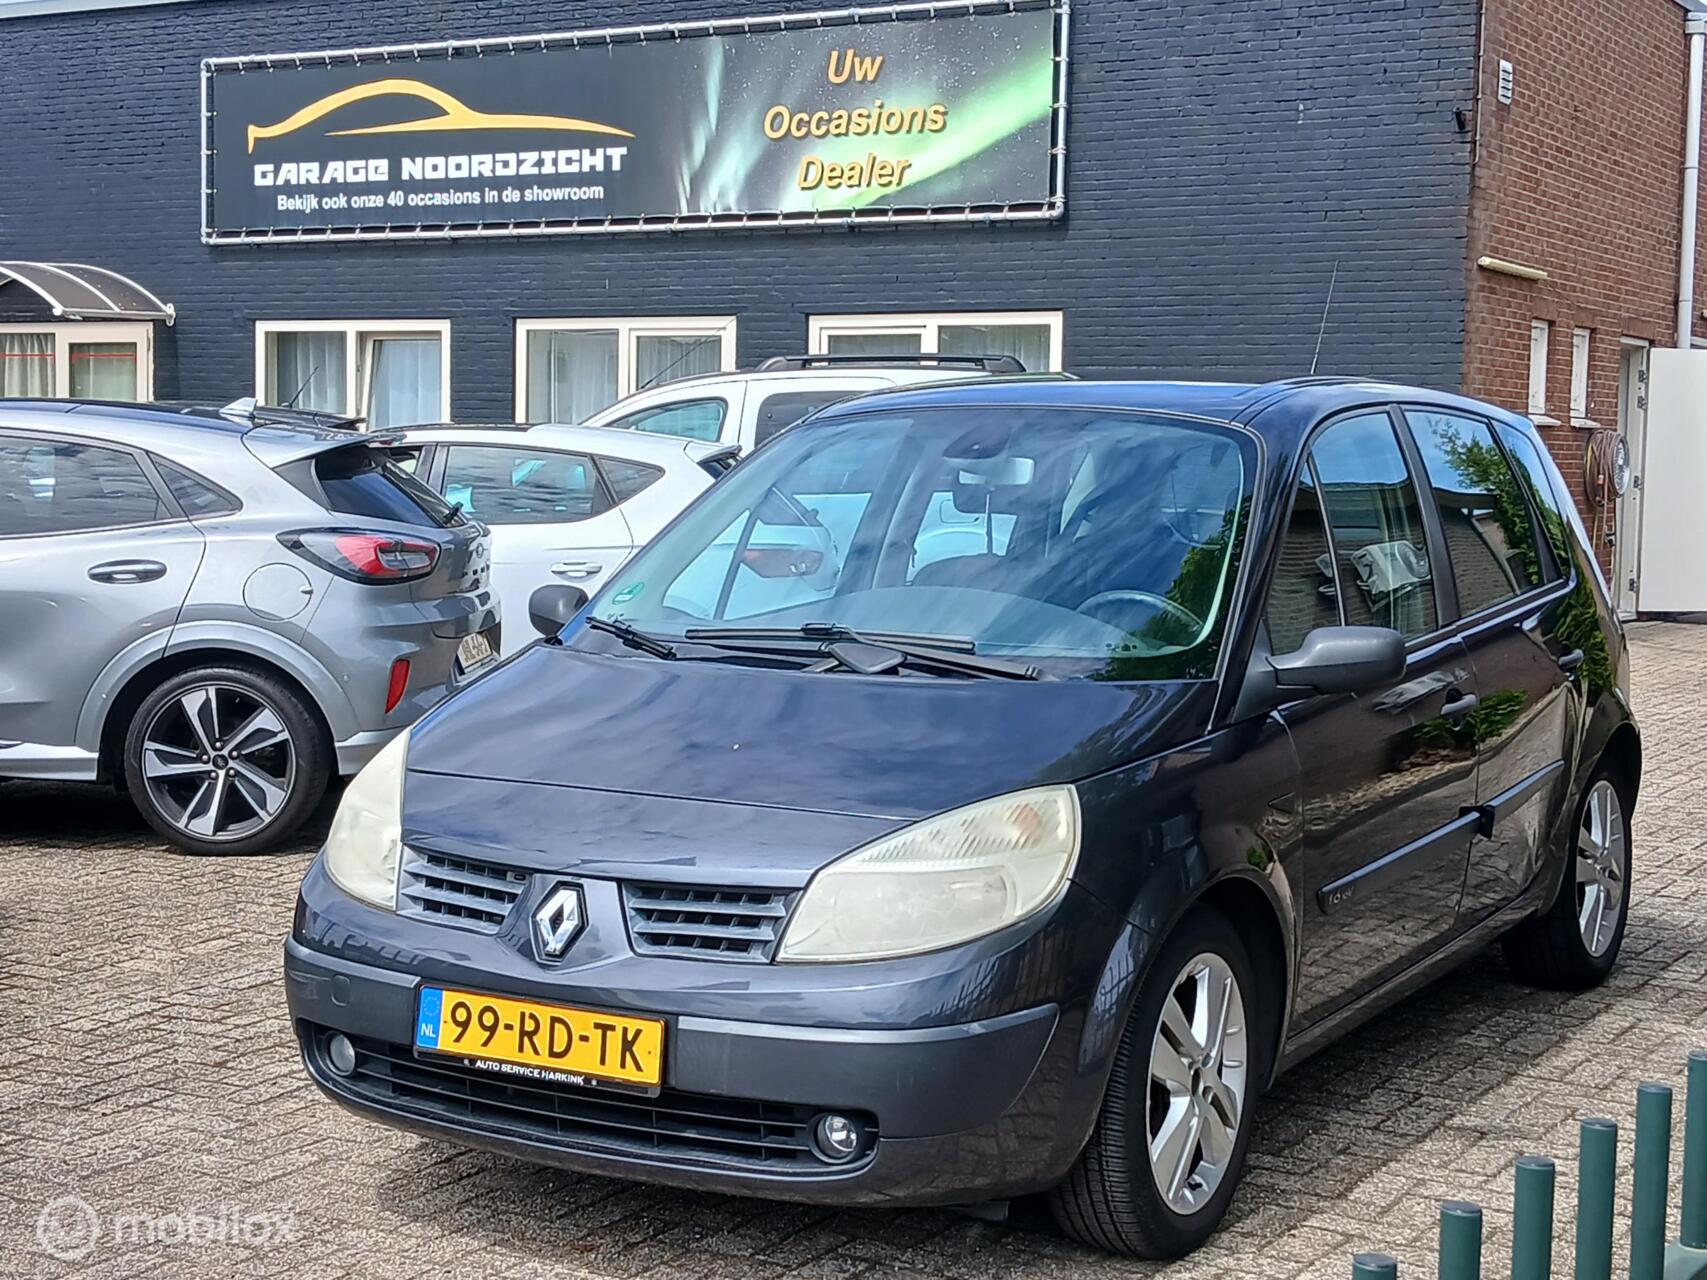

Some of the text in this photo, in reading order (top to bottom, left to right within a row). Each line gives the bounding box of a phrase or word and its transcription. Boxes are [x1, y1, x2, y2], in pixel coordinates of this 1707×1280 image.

[827, 49, 883, 84] Uw
[763, 99, 947, 140] Occasions
[254, 147, 628, 186] GARAGE NOORDZICHT
[798, 152, 911, 190] Dealer
[277, 184, 605, 213] Bekijk ook onze 40 occasions in de showroom
[420, 1023, 437, 1038] NL
[450, 1000, 645, 1073] 99-RD-TK
[475, 1059, 586, 1085] AUTO SERVICE HARKINK
